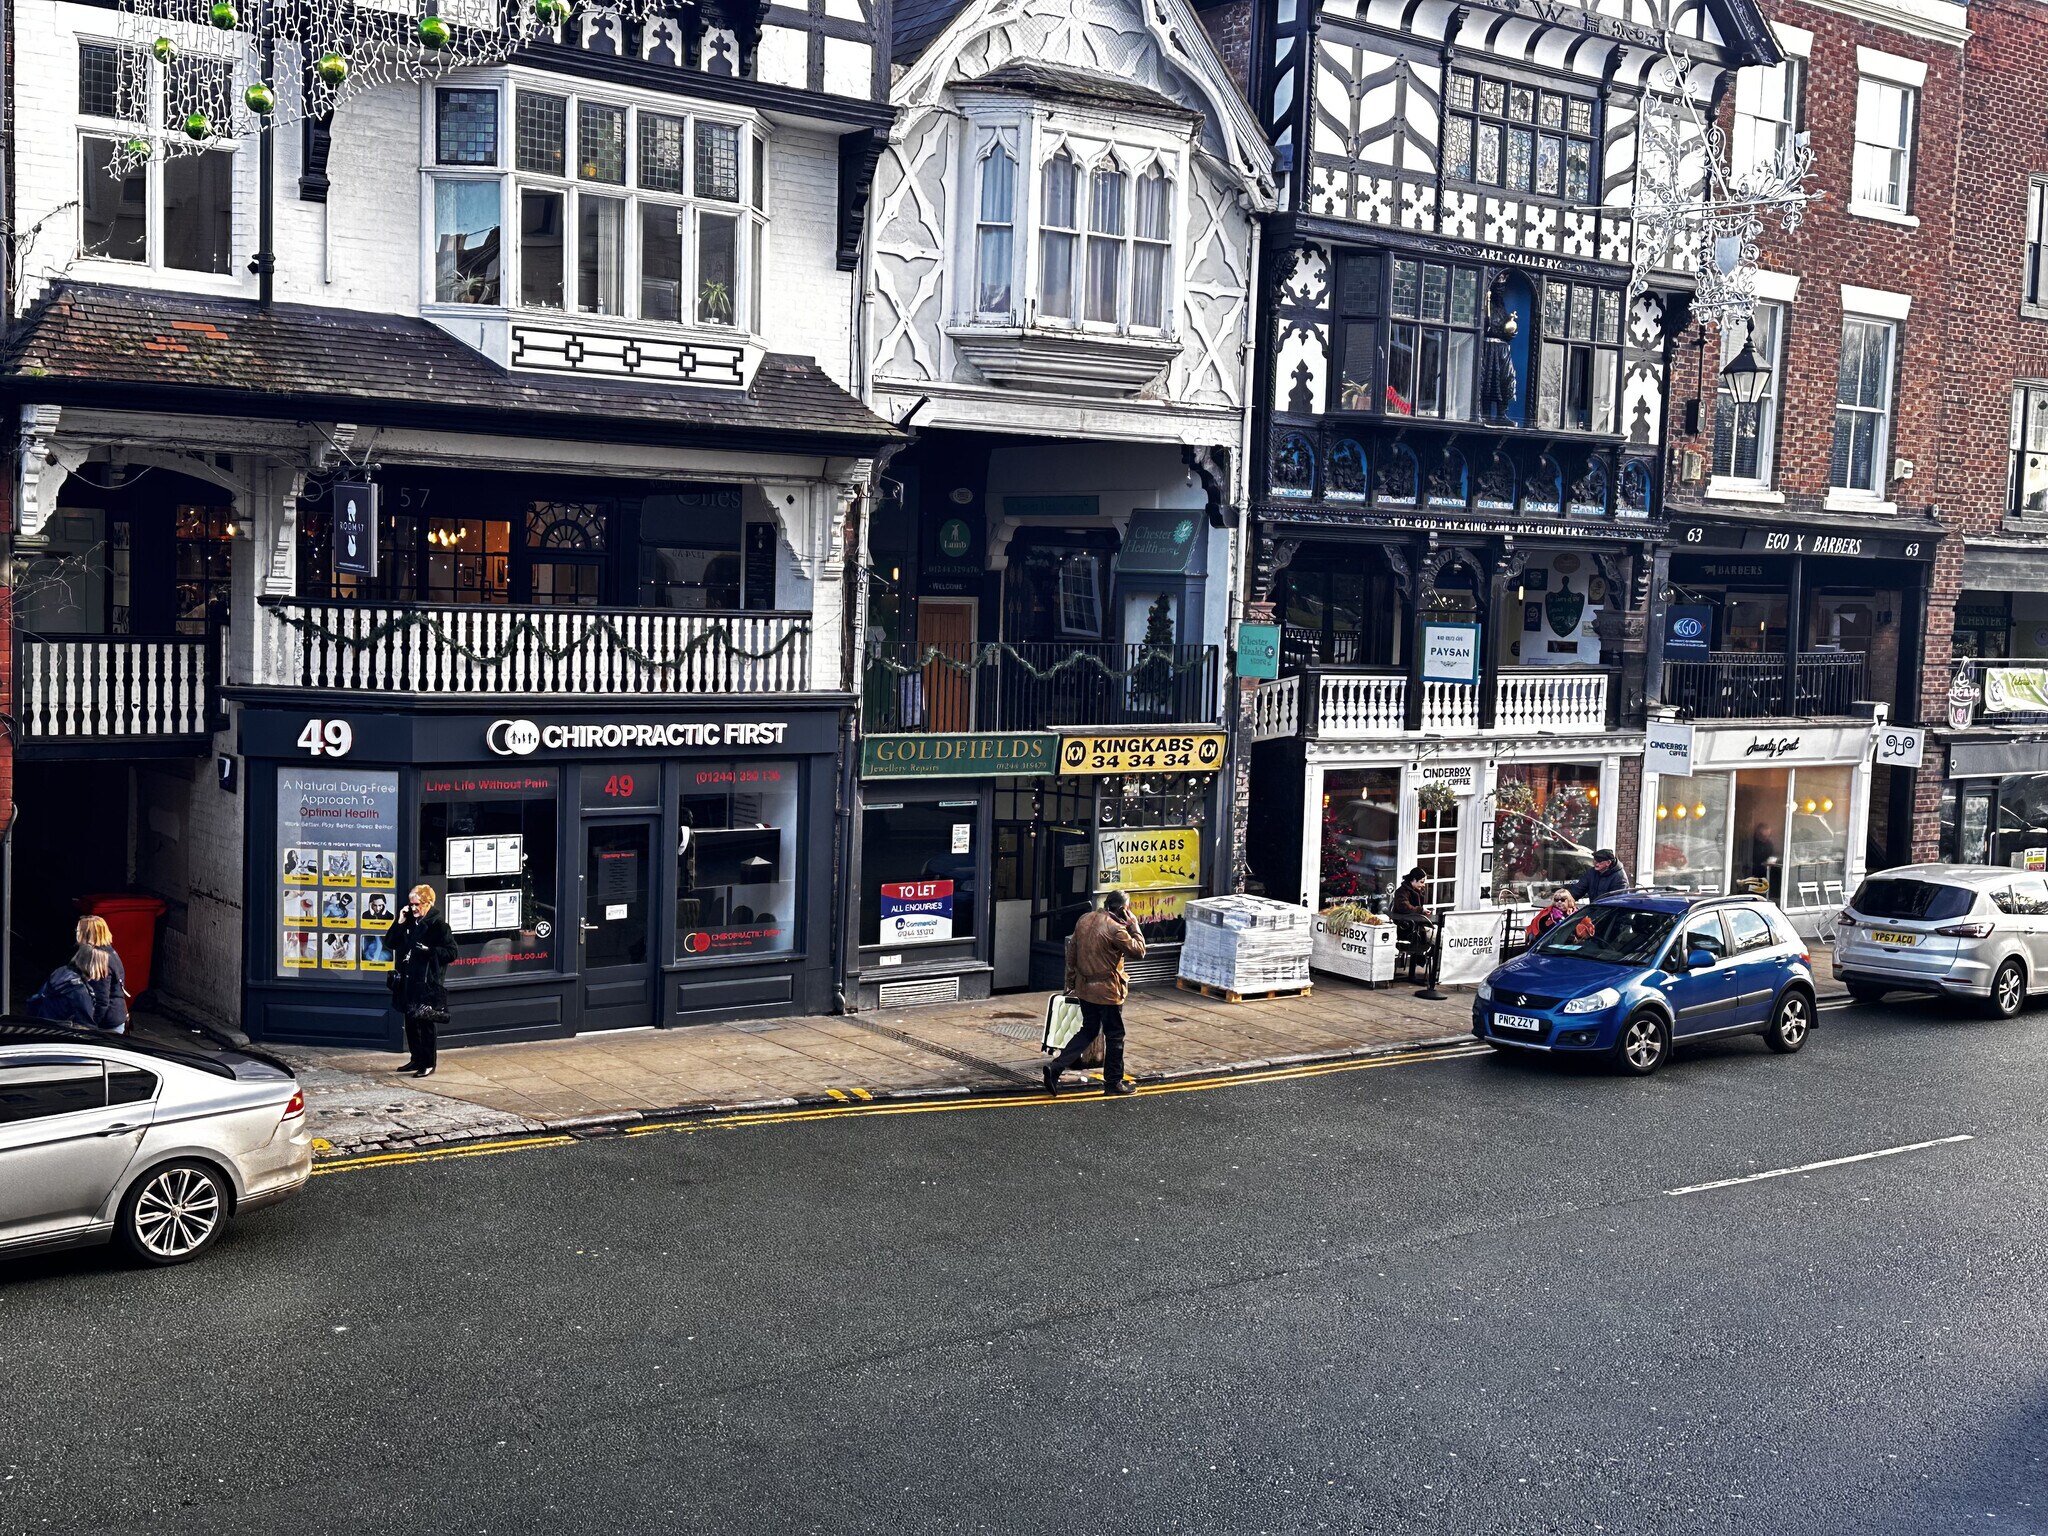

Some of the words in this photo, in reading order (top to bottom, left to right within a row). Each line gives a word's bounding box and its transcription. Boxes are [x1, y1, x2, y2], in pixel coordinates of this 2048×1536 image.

[1479, 248, 1503, 261] ART
[1508, 253, 1561, 270] GALLERY
[400, 487, 430, 508] 57
[1135, 526, 1173, 540] Chester
[1392, 518, 1407, 527] TO
[1415, 519, 1437, 529] GOD
[1444, 521, 1460, 530] MY
[1464, 522, 1487, 531] KING
[1494, 524, 1510, 532] AND
[1517, 525, 1531, 533] MY
[1536, 526, 1585, 536] COUNTRY
[1686, 528, 1703, 543] 63
[1125, 539, 1158, 553] Health
[1794, 534, 1805, 551] X
[1812, 536, 1862, 555] BARBERS
[1906, 543, 1920, 557] 63
[1717, 565, 1763, 576] BARBERS
[1430, 647, 1470, 657] PAYSAN
[297, 719, 353, 757] 49
[542, 723, 720, 749] CHIROPRACTIC
[724, 723, 788, 745] FIRST
[876, 739, 1043, 761] GOLDFIELDS
[1092, 738, 1194, 754] KINGKABS
[1650, 740, 1688, 751] CINDERBOX
[1091, 755, 1120, 768] 34
[1128, 754, 1156, 767] 34
[1163, 753, 1190, 766] 34
[696, 771, 736, 785] (01244)
[1423, 766, 1471, 778] CINDERBOX
[283, 780, 292, 790] A
[295, 780, 337, 791] Natural
[340, 781, 396, 795] Drug-Free
[426, 782, 451, 791] Live
[454, 781, 476, 791] Life
[479, 780, 522, 790] Without
[524, 778, 548, 788] Pain
[604, 775, 634, 797] 49
[1447, 777, 1471, 786] COFFEE
[300, 794, 359, 806] Approach
[362, 795, 375, 806] To
[300, 807, 342, 818] Optimal
[345, 808, 380, 819] Health
[1117, 839, 1185, 853] KINGKABS
[1119, 855, 1144, 865] 01244
[1147, 855, 1157, 863] 34
[1159, 854, 1169, 862] 34
[1171, 853, 1181, 862] 34
[899, 885, 915, 898] TO
[917, 884, 936, 897] LET
[891, 905, 903, 913] ALL
[905, 902, 943, 912] ENQUIRIES
[906, 919, 938, 928] Commercial
[1316, 922, 1368, 942] CINDERBOX
[1875, 932, 1896, 942] YP67
[1341, 942, 1367, 955] COFFEE
[1449, 936, 1494, 948] CINDERBOX
[1472, 947, 1493, 956] COFFEE
[1498, 1015, 1516, 1027] PN12
[1517, 1017, 1534, 1028] ZZY
